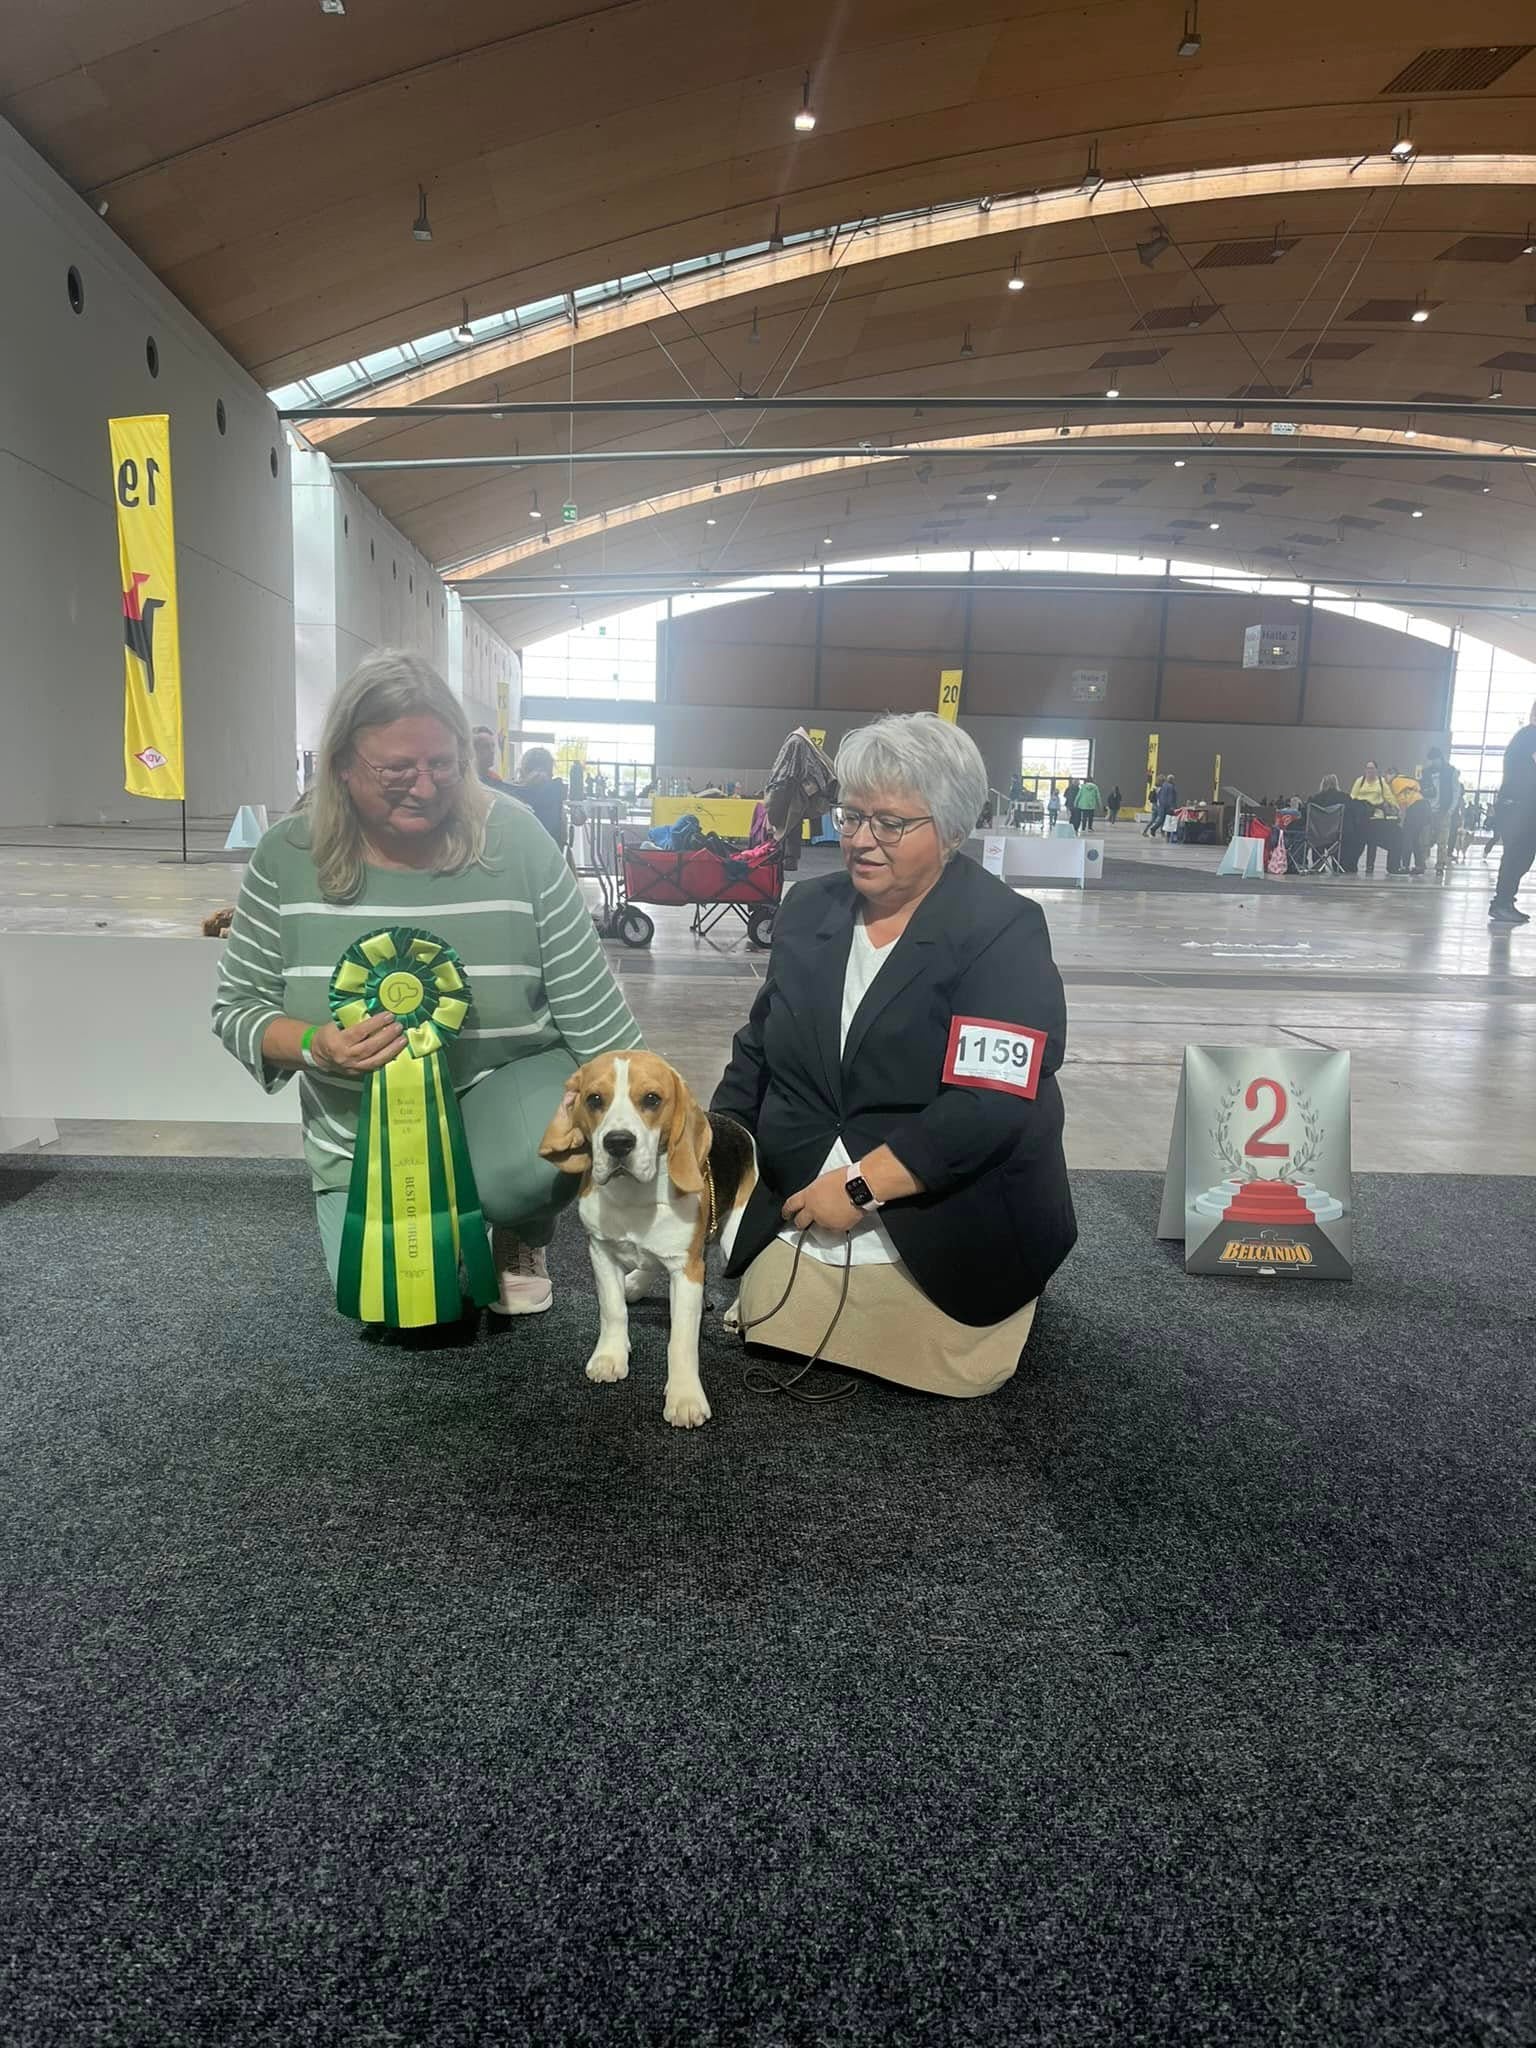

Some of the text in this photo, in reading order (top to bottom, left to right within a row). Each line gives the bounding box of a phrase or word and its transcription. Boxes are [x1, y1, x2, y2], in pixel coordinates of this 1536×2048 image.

[1290, 631, 1297, 641] 2
[943, 685, 959, 703] 20
[959, 1035, 1029, 1068] 1159
[1245, 1077, 1289, 1157] 2
[405, 1176, 415, 1202] BEST
[407, 1206, 417, 1218] OF
[1221, 1241, 1312, 1263] BELCANDO
